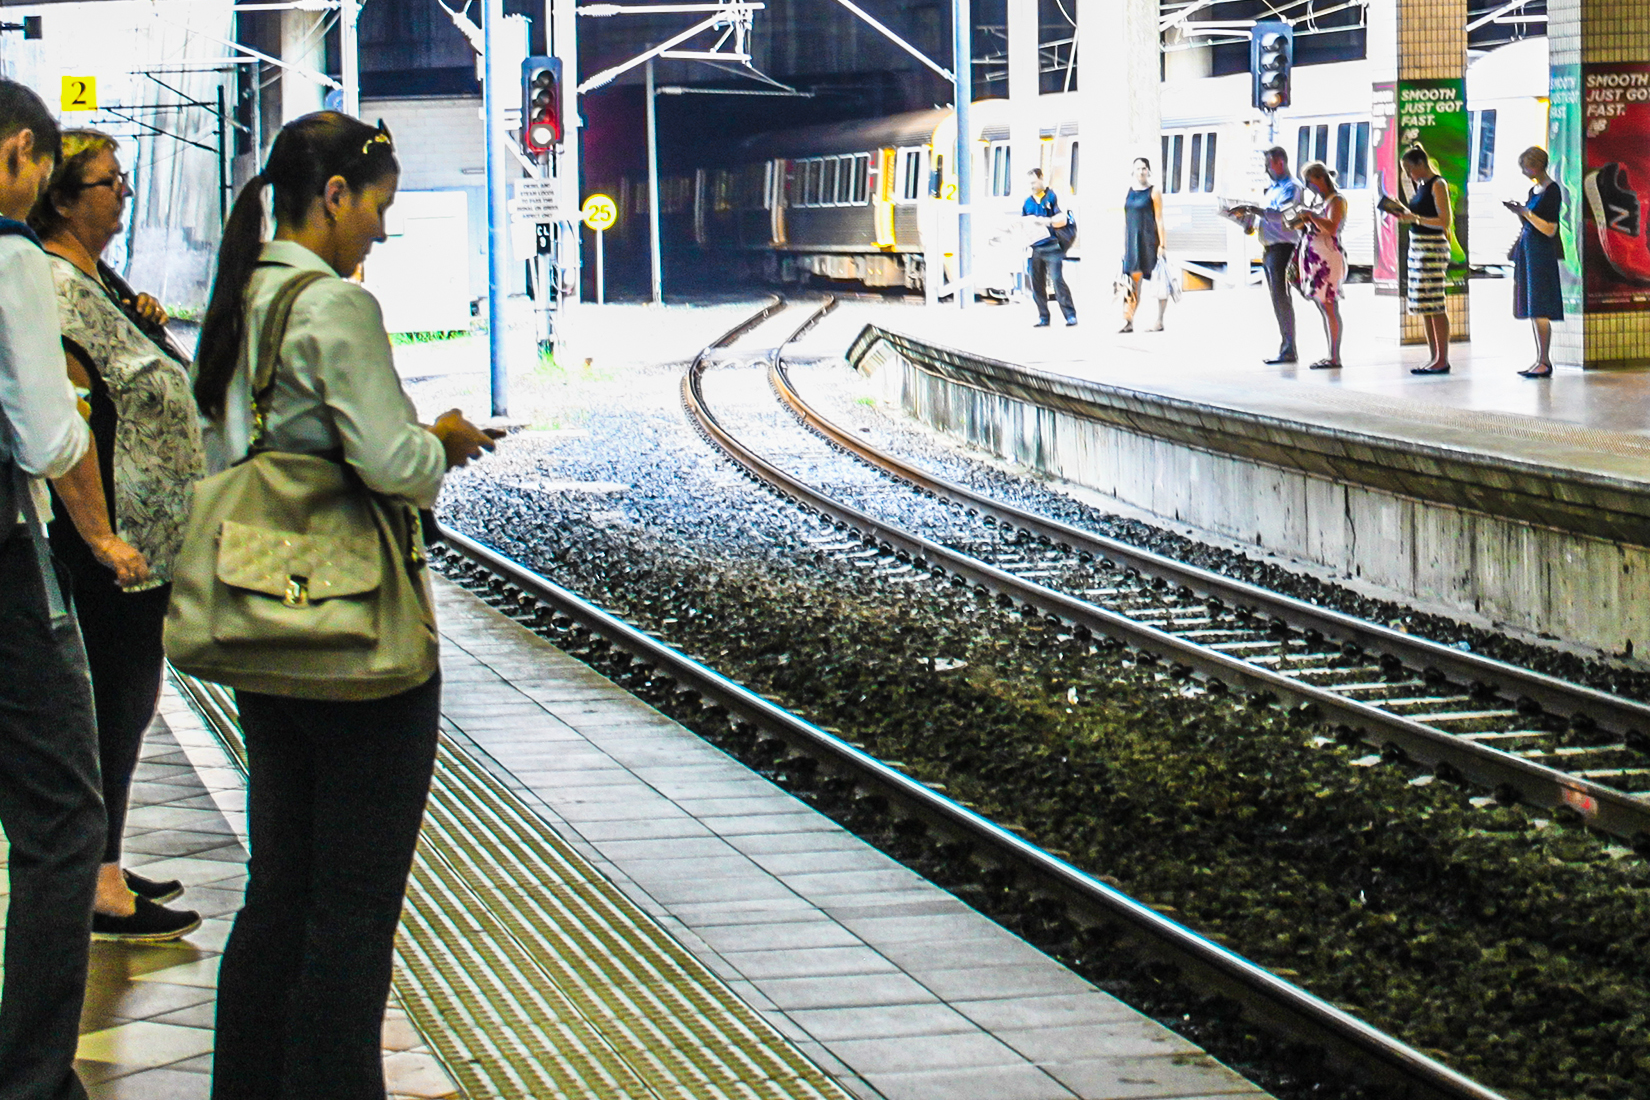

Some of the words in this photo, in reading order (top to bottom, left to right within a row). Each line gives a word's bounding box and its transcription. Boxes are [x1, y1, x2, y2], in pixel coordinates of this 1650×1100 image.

[1586, 72, 1650, 88] SMOOTH
[71, 81, 87, 105] 2
[1400, 87, 1457, 102] SMOOTH
[1586, 88, 1625, 103] JUST
[1400, 101, 1435, 115] JUST
[1435, 100, 1464, 113] GOT
[1586, 102, 1626, 117] FAST.
[1401, 114, 1436, 127] FAST.
[588, 204, 612, 222] 25
[537, 225, 550, 236] CL
